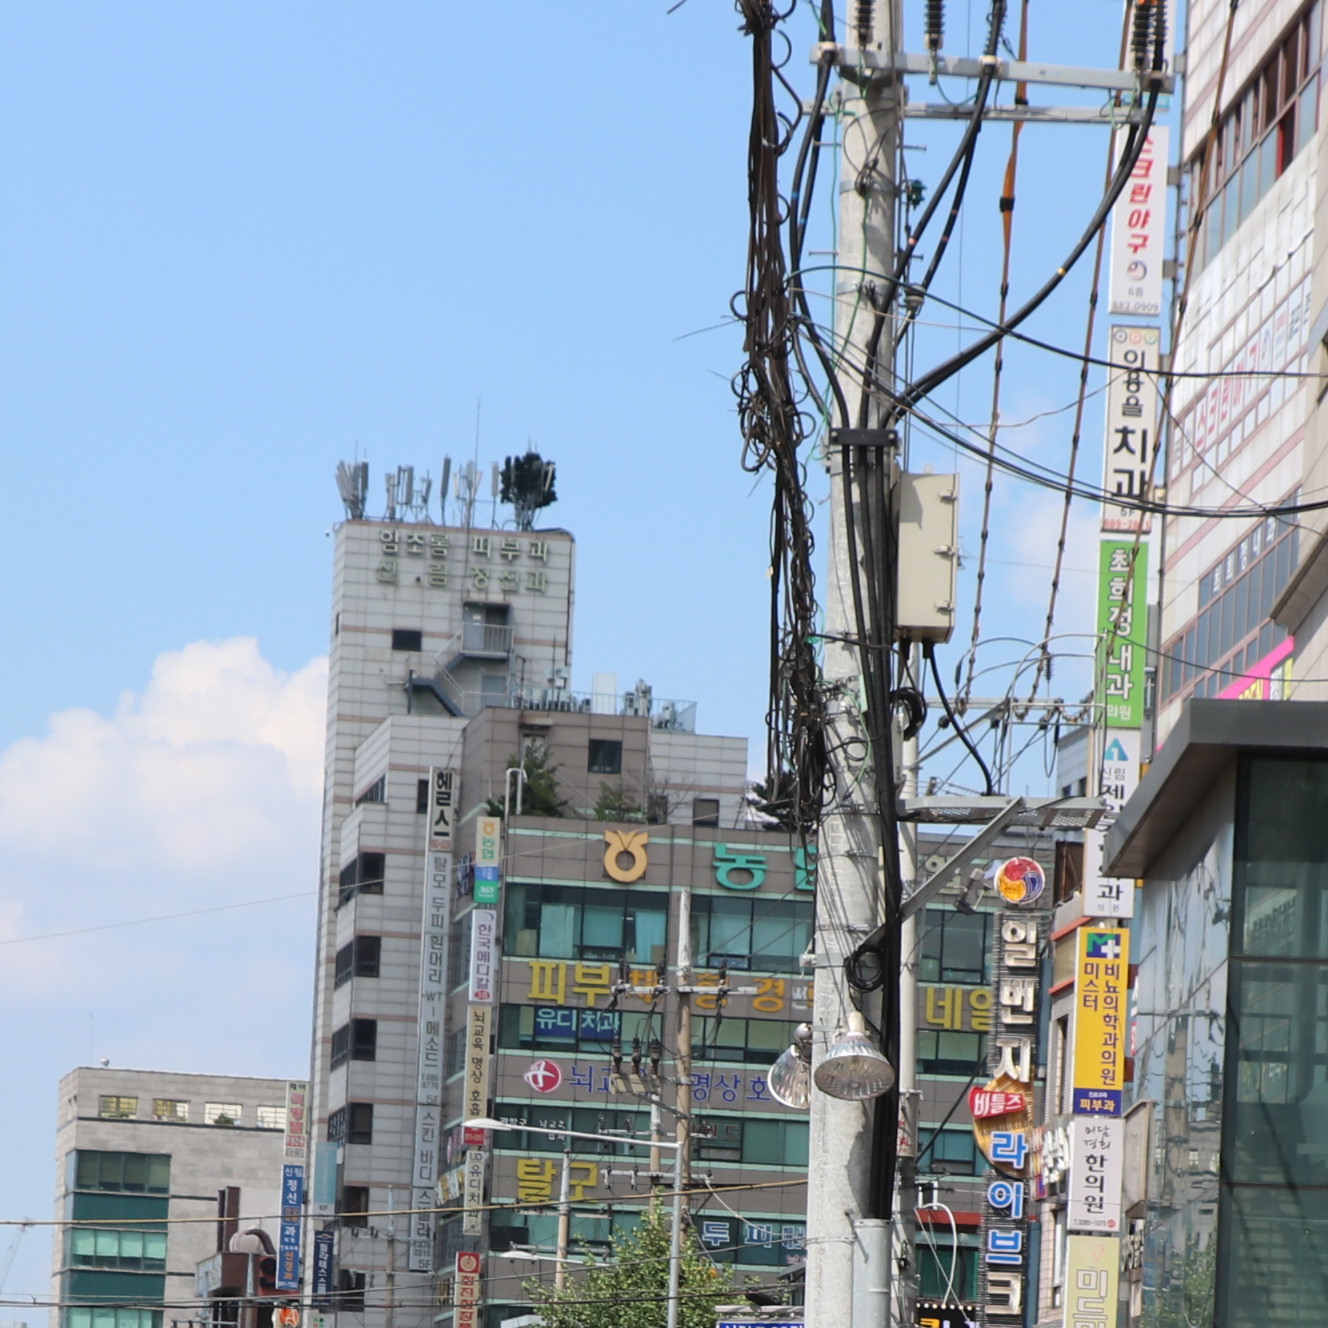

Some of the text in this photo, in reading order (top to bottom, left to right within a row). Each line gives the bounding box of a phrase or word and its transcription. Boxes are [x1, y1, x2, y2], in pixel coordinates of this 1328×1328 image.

[1110, 426, 1148, 504] 치과
[472, 536, 550, 562] 피부과
[1107, 703, 1132, 721] 의원
[528, 960, 613, 1007] 피부
[1082, 962, 1100, 1013] 미스터
[1099, 961, 1122, 1087] 비뇨의학과의원
[973, 1091, 1024, 1117] 비틀즈
[1079, 1098, 1117, 1114] 피부과
[984, 1131, 1030, 1266] 라이브
[1083, 1153, 1109, 1216] 한의원
